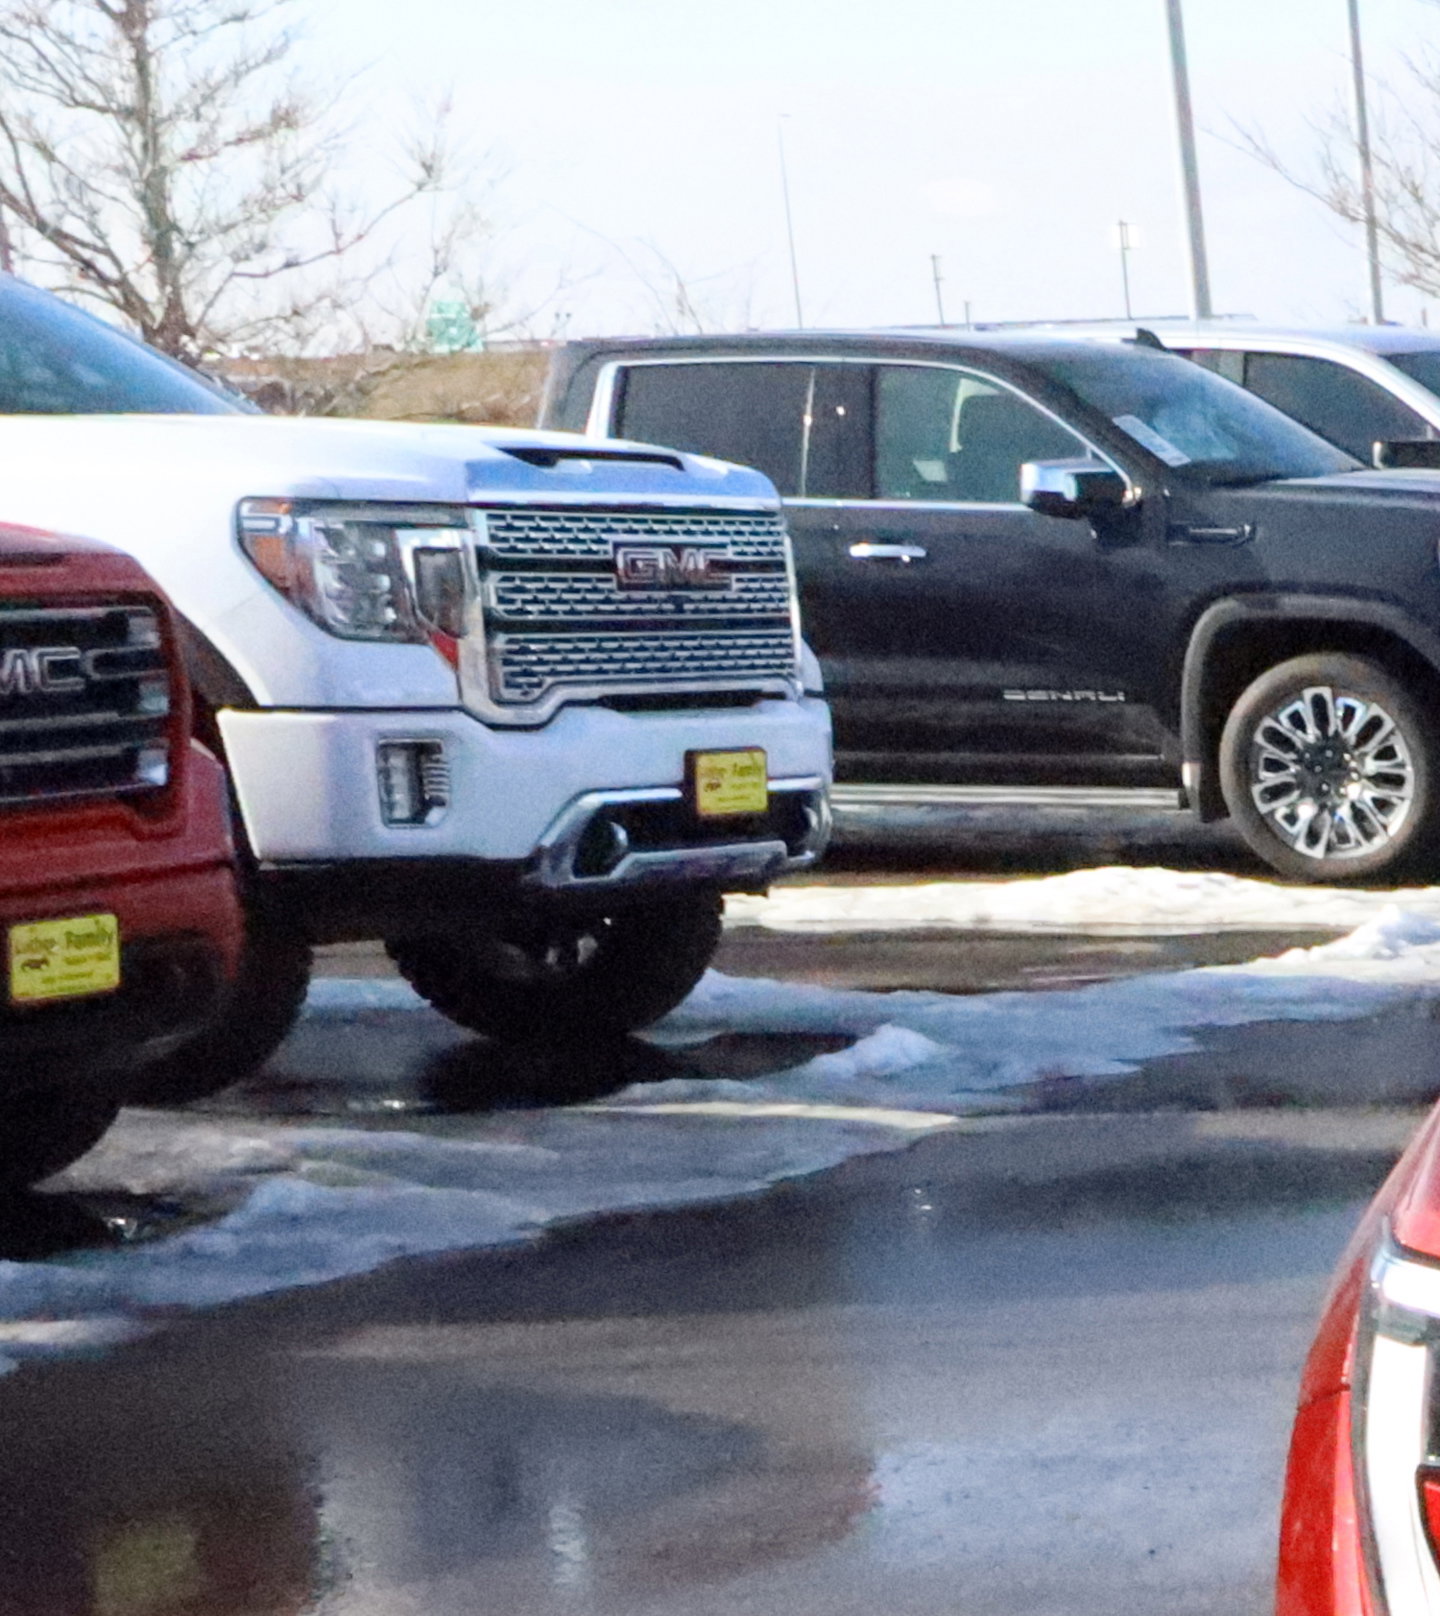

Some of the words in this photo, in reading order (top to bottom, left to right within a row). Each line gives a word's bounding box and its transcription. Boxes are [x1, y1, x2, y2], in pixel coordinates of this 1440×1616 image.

[616, 547, 732, 584] GMC
[0, 647, 86, 695] MC
[1003, 690, 1126, 702] DENALI
